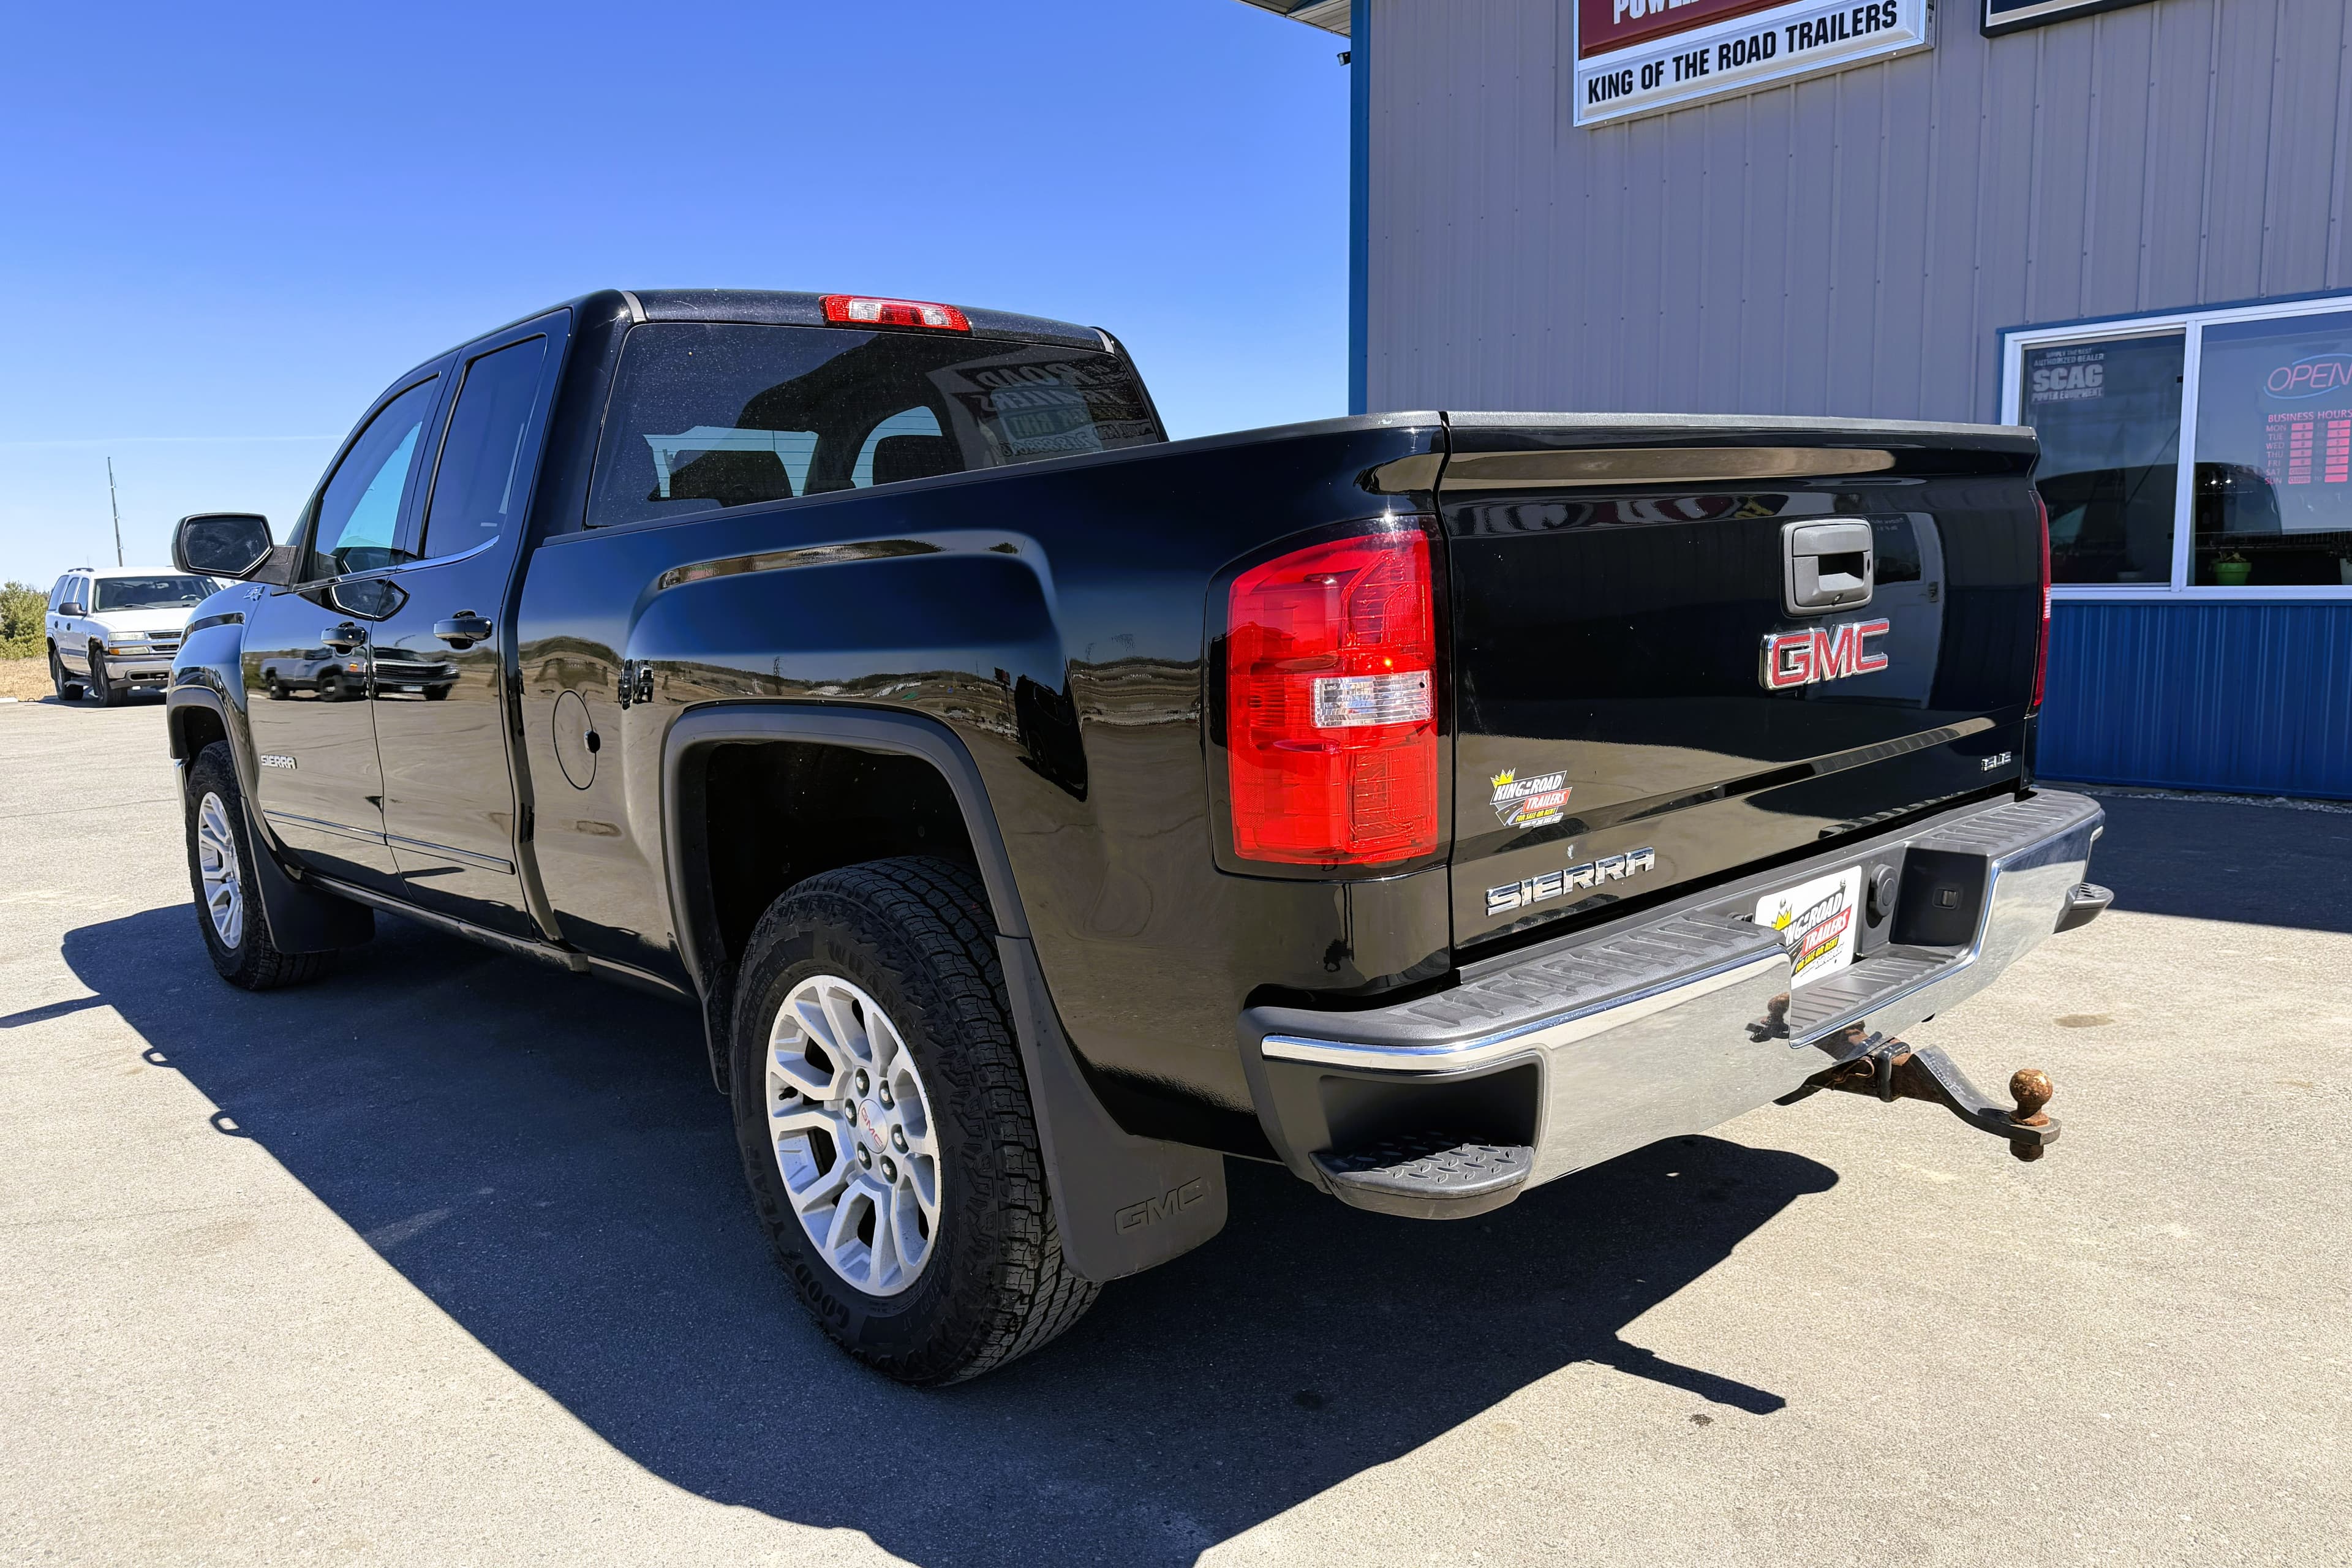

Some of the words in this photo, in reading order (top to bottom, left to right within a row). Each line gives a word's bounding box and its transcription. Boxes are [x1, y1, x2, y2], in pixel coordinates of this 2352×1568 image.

[1588, 69, 1633, 104] KING
[1642, 60, 1664, 89] OF
[1672, 48, 1709, 82] THE
[1718, 31, 1776, 71] ROAD
[1785, 0, 1897, 53] TRAILERS
[2034, 356, 2076, 366] AUTHORIZED
[2078, 353, 2104, 362] DEALER
[2034, 364, 2103, 392] SCAG
[2268, 363, 2352, 391] OPEN
[2032, 391, 2058, 402] POWER
[2060, 387, 2102, 399] EQUIPMENT
[2268, 412, 2314, 423] BUSINESS
[2318, 410, 2352, 419] HOURS
[1759, 618, 1890, 690] GMC
[260, 755, 296, 769] SIERRA
[1493, 781, 1526, 802] KING
[1529, 775, 1562, 794] ROAD
[1526, 791, 1567, 810] TRAILERS
[1486, 846, 1655, 916] SIERRA
[1782, 916, 1804, 946] NG
[1808, 893, 1843, 929] ROAD
[1804, 911, 1849, 952] TRAILERS
[1795, 959, 1804, 973] FOR
[1804, 950, 1816, 966] SALE
[1815, 946, 1825, 957] OR
[1825, 937, 1839, 952] RENT
[861, 1106, 883, 1148] GMC
[1115, 1177, 1204, 1235] GMC
